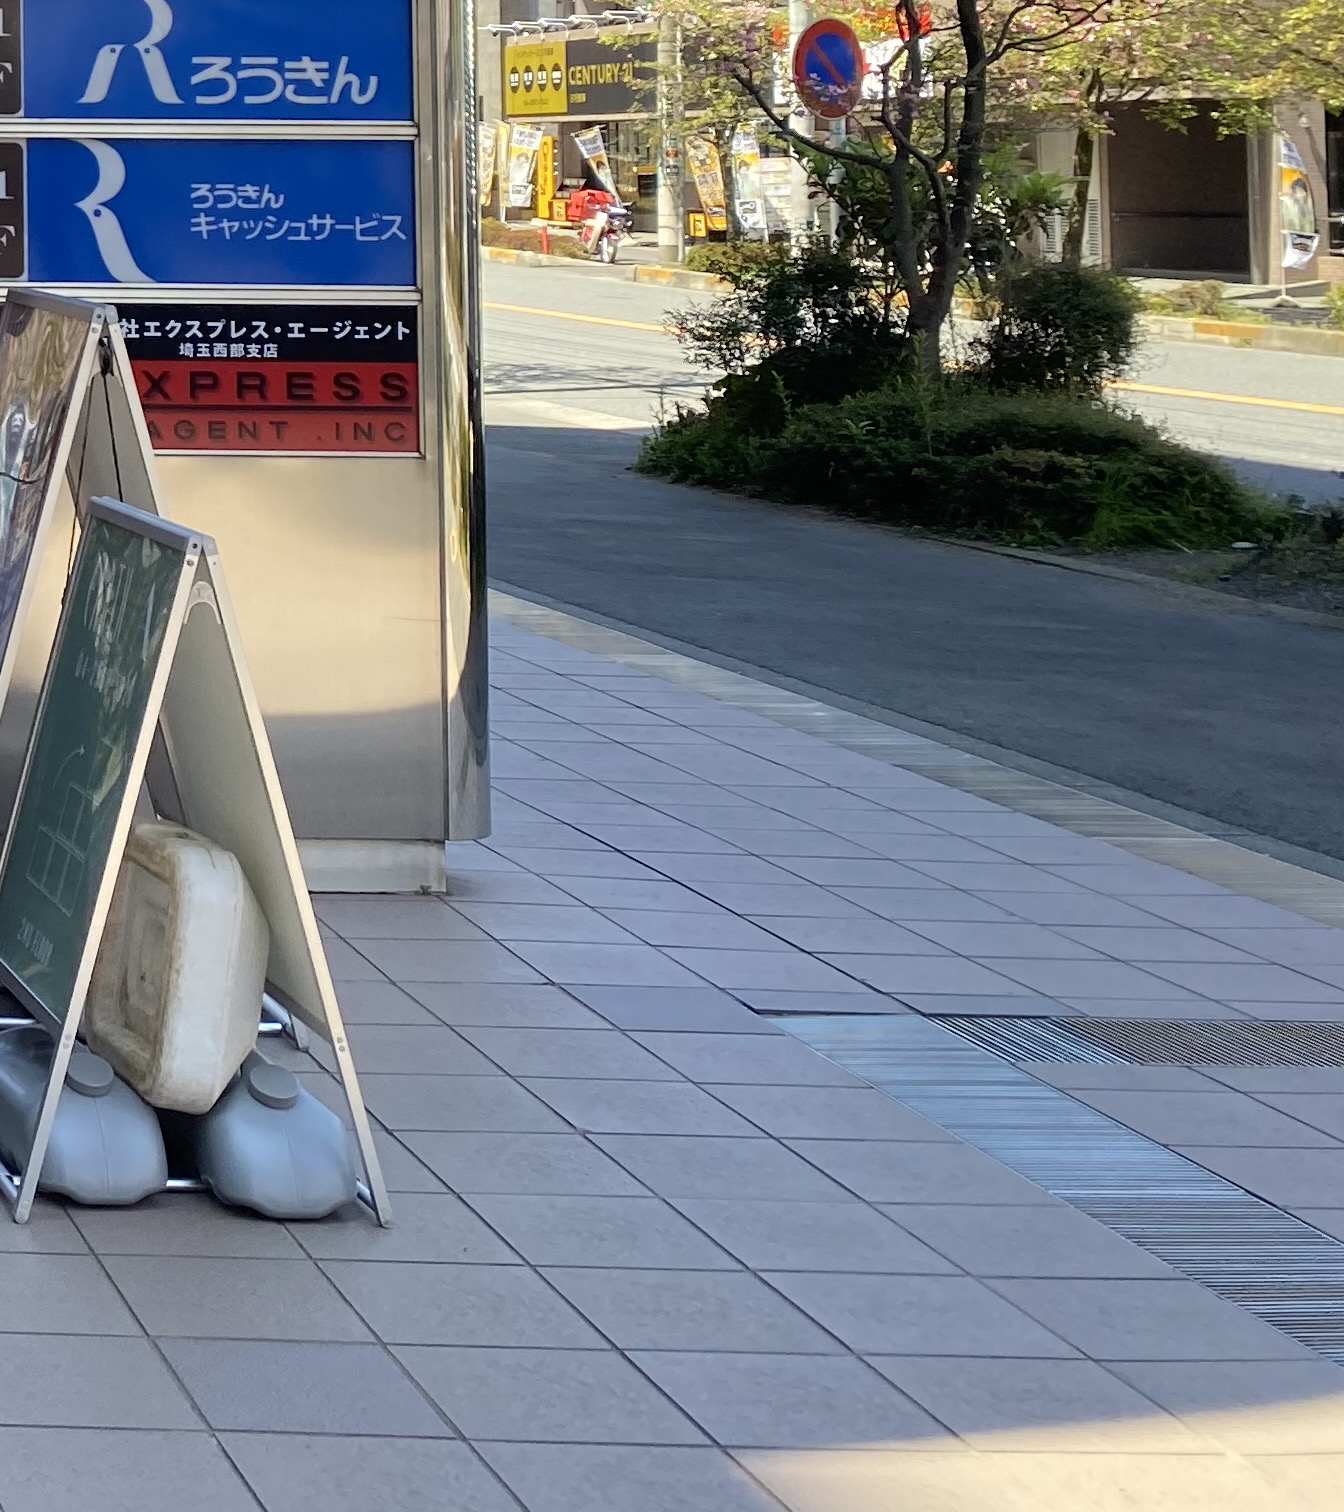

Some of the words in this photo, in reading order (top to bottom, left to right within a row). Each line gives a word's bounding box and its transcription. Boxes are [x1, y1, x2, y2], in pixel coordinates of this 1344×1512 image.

[190, 55, 379, 105] ろうきん
[568, 63, 620, 85] CENTURY
[189, 183, 285, 210] ろうきん
[189, 211, 408, 241] キャッシュサービス
[119, 318, 410, 341] 社エクスプレス・エージェント
[178, 342, 279, 359] 埼玉西部支店
[141, 369, 409, 402] XPRESS
